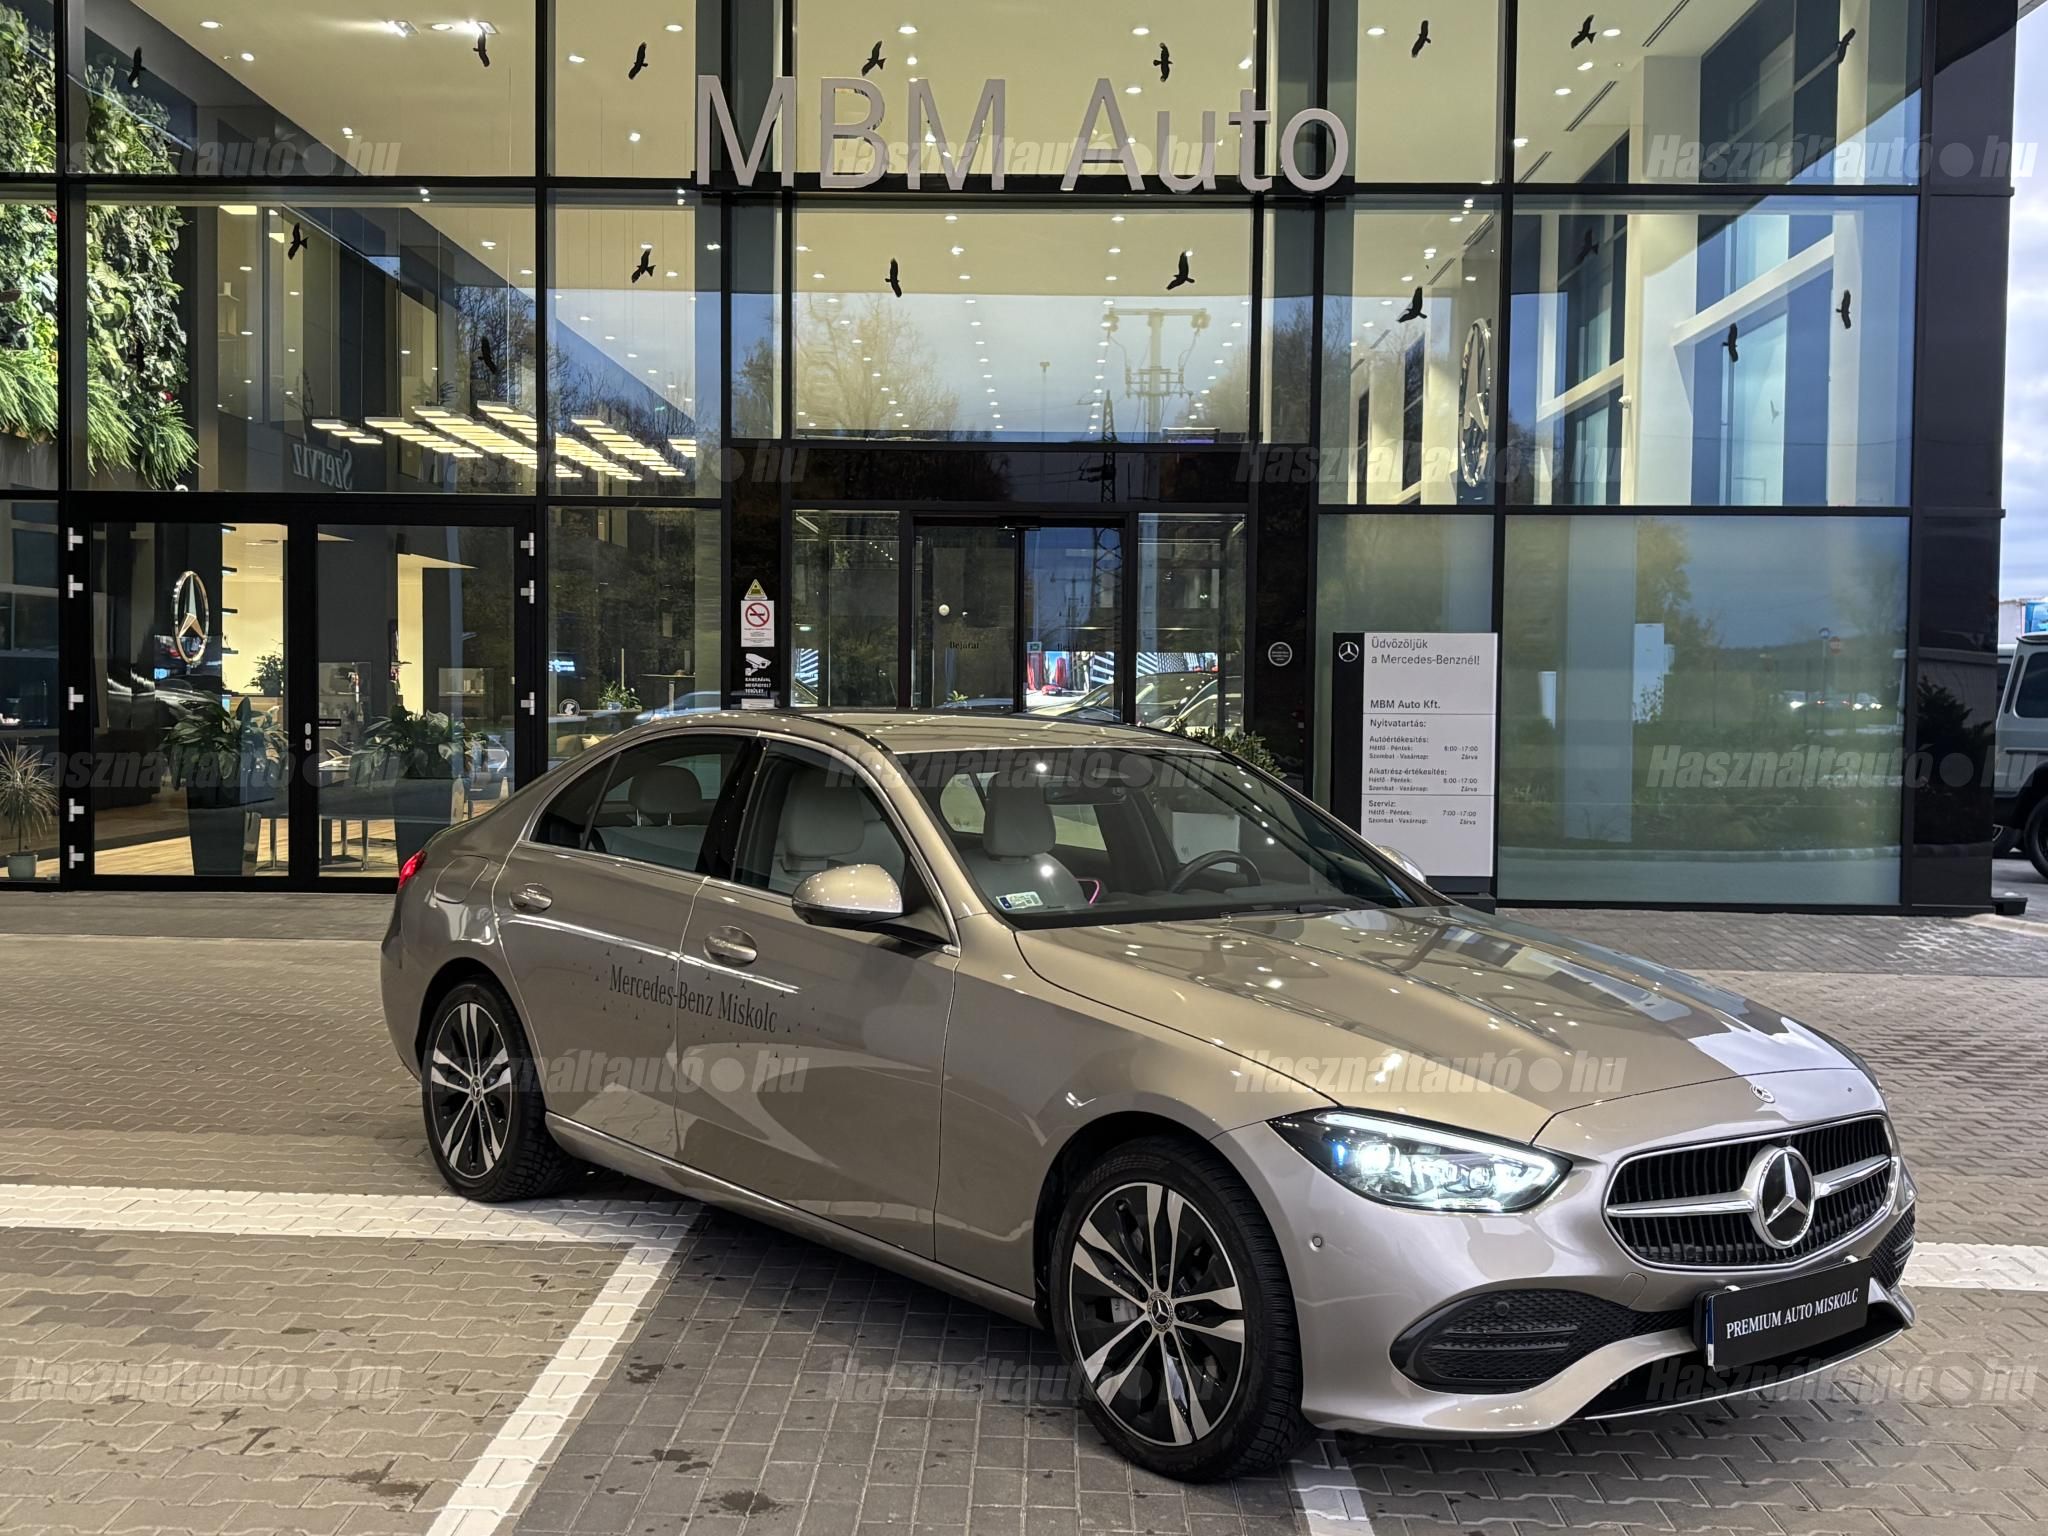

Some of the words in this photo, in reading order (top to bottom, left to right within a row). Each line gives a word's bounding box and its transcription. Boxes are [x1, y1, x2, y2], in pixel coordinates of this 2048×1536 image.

[696, 74, 1005, 191] MBM
[1060, 76, 1350, 195] Auto
[1371, 637, 1428, 651] Üdvözöljük
[1371, 656, 1377, 664] a
[1381, 654, 1480, 666] Mercedes-Benznél!
[1370, 699, 1395, 709] MBM
[1398, 700, 1421, 709] Auto
[1423, 699, 1441, 709] Kft.
[1370, 719, 1427, 729] Nyitvatartás:
[609, 964, 713, 1017] Mercedes-Benz
[718, 991, 778, 1034] Miskolc
[1726, 1310, 1782, 1339] PREMIUM
[1784, 1303, 1813, 1325] AUTO
[1814, 1288, 1859, 1317] MISKOLC
